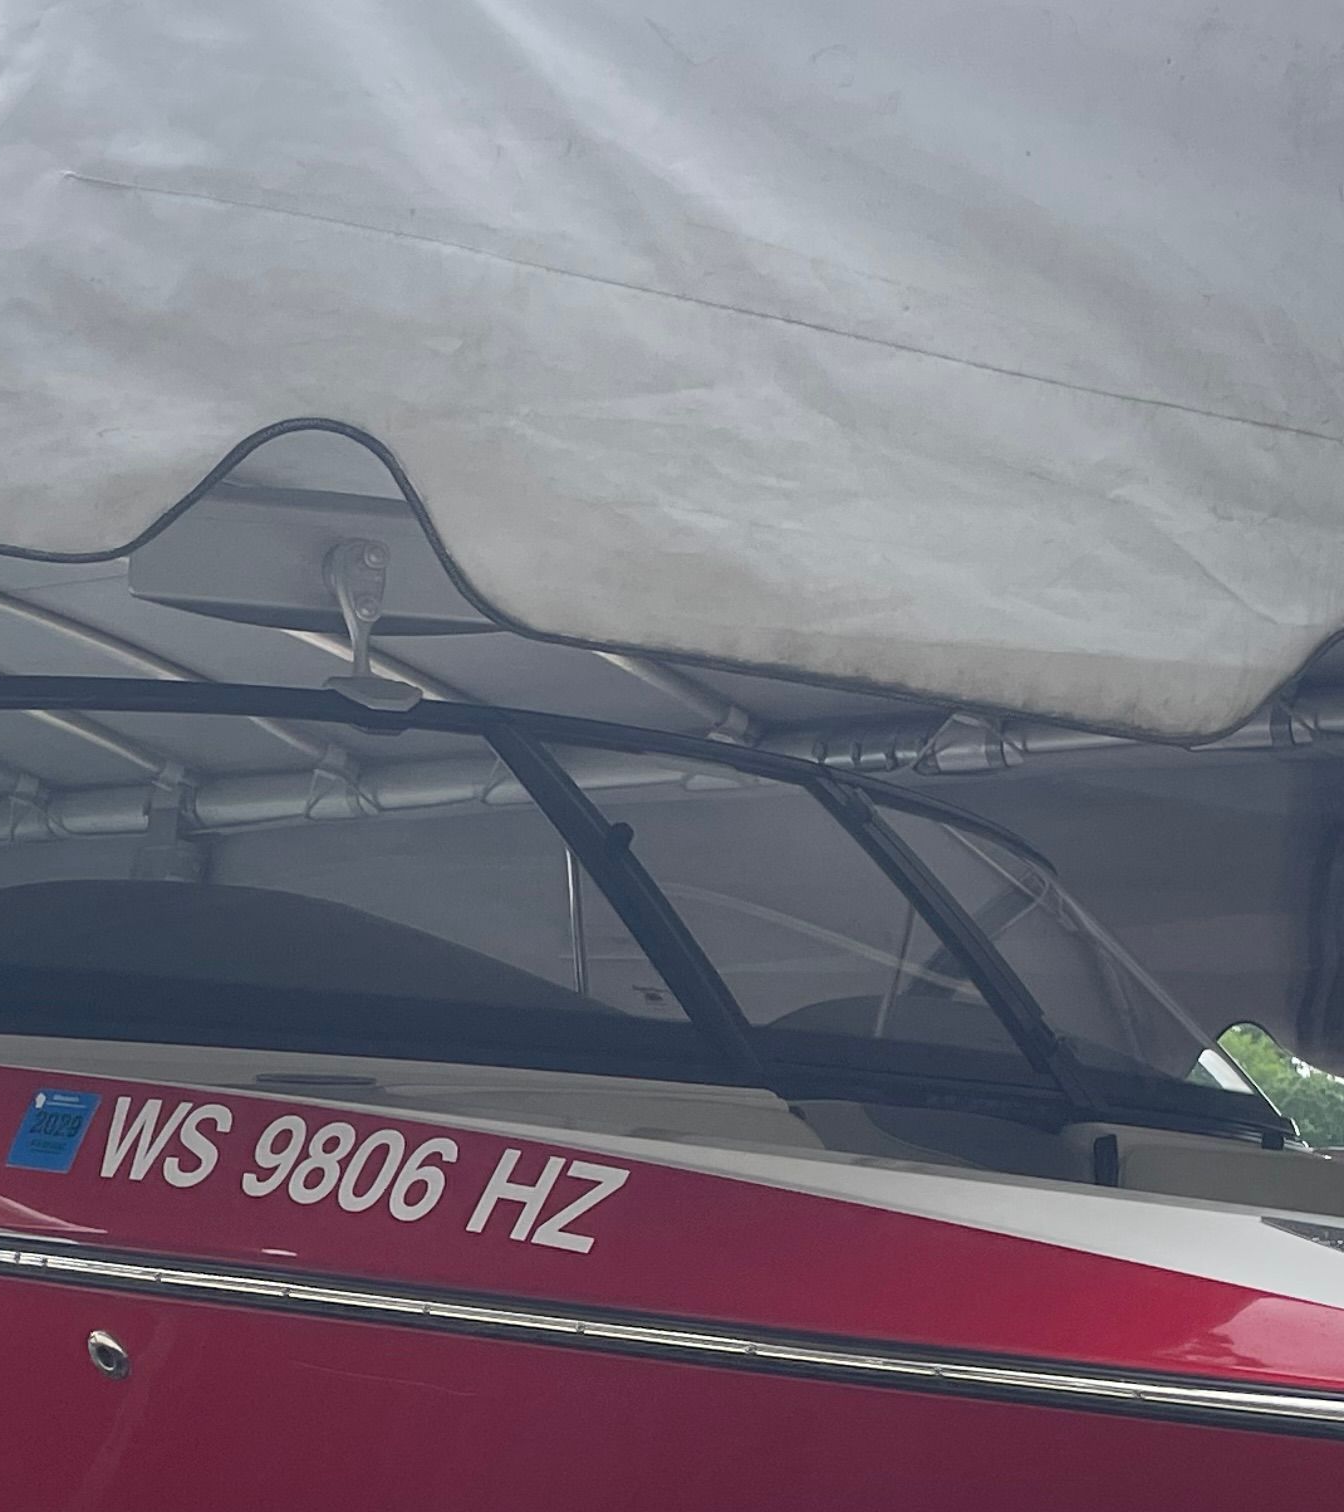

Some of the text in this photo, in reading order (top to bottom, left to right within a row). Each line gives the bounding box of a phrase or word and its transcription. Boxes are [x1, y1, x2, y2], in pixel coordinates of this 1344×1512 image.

[99, 1096, 630, 1254] WS 9806 HZ
